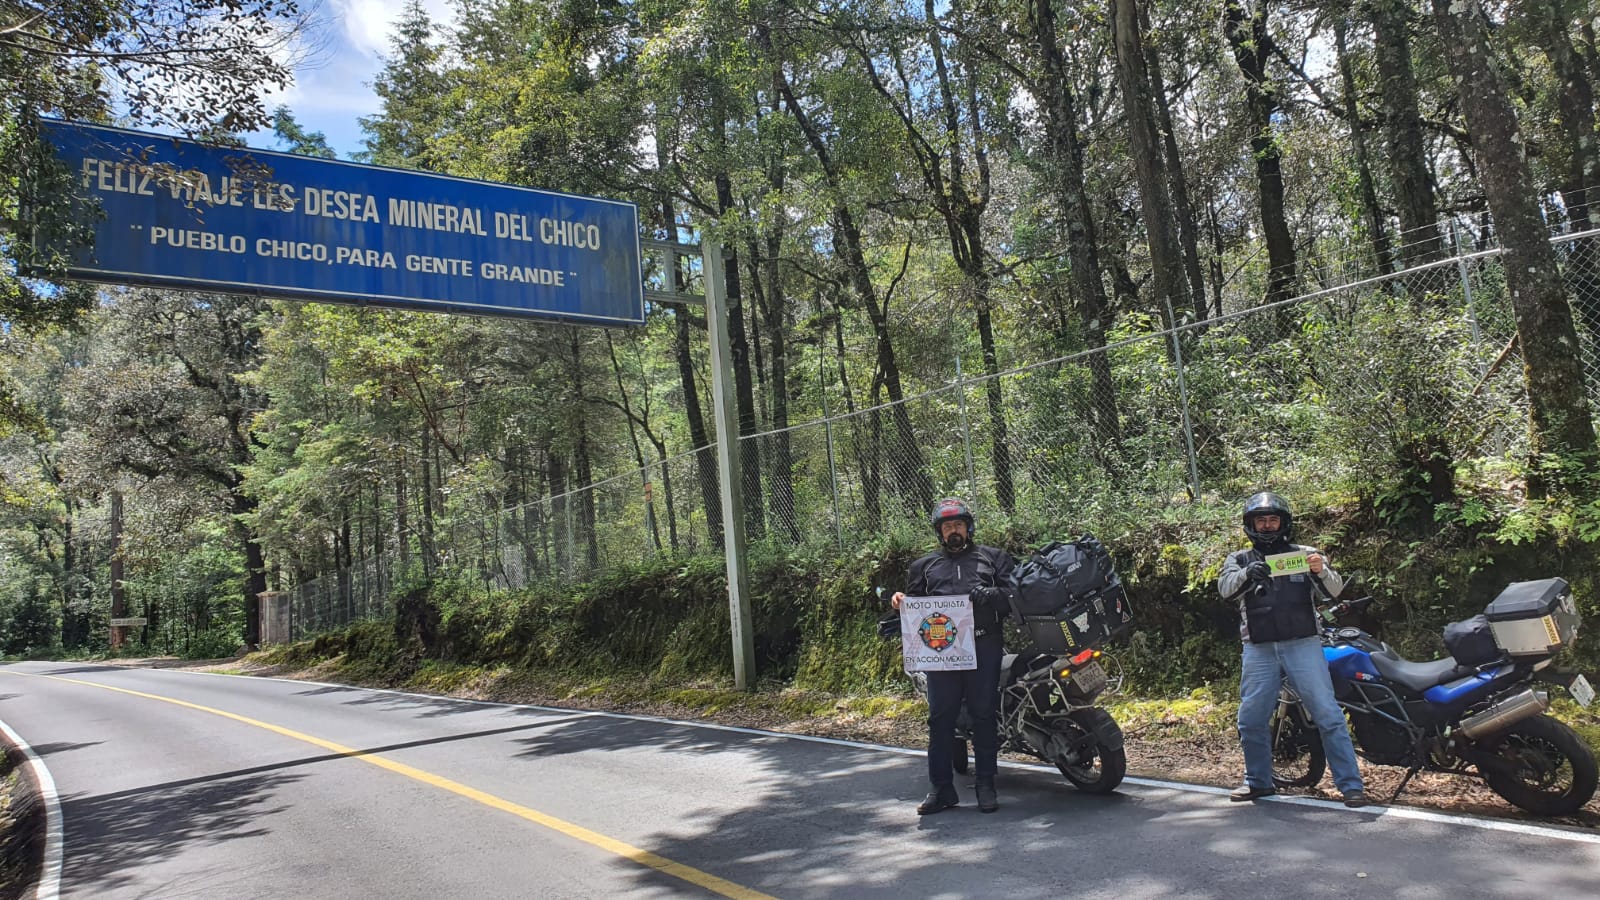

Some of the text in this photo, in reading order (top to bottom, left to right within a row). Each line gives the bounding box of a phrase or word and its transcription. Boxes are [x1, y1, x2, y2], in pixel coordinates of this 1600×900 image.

[81, 157, 601, 251] FELIZ VIAJE LES DESEA MINERAL DEL CHICO
[151, 226, 247, 254] PUEBLO
[405, 254, 473, 277] GENTE
[480, 262, 565, 287] GRANDE
[906, 600, 965, 610] MOTO TURISTA
[905, 656, 915, 664] EN
